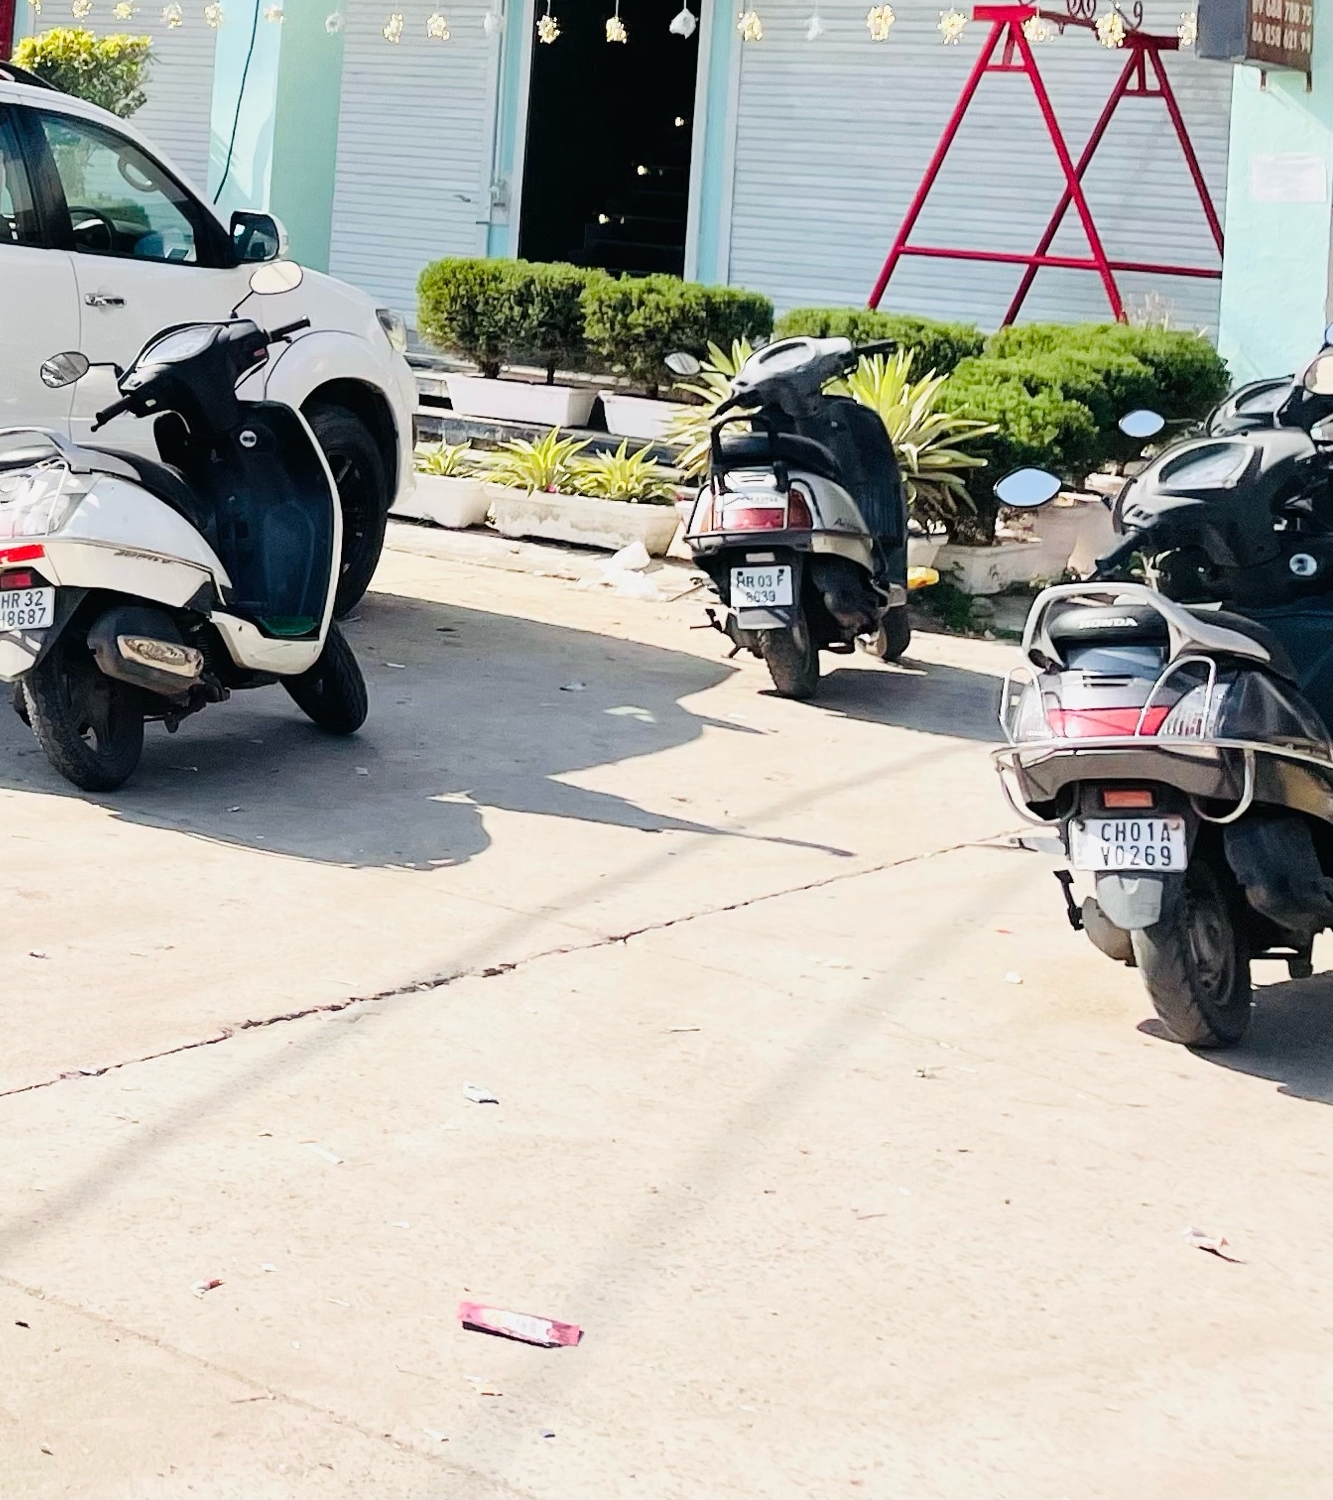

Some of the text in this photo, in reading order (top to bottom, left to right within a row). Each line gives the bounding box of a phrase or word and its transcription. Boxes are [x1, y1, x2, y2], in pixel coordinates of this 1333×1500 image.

[737, 574, 754, 588] HR
[758, 574, 772, 588] 03
[1, 590, 44, 608] HR 32
[1078, 617, 1138, 630] HONDA
[1101, 821, 1171, 843] CH01A
